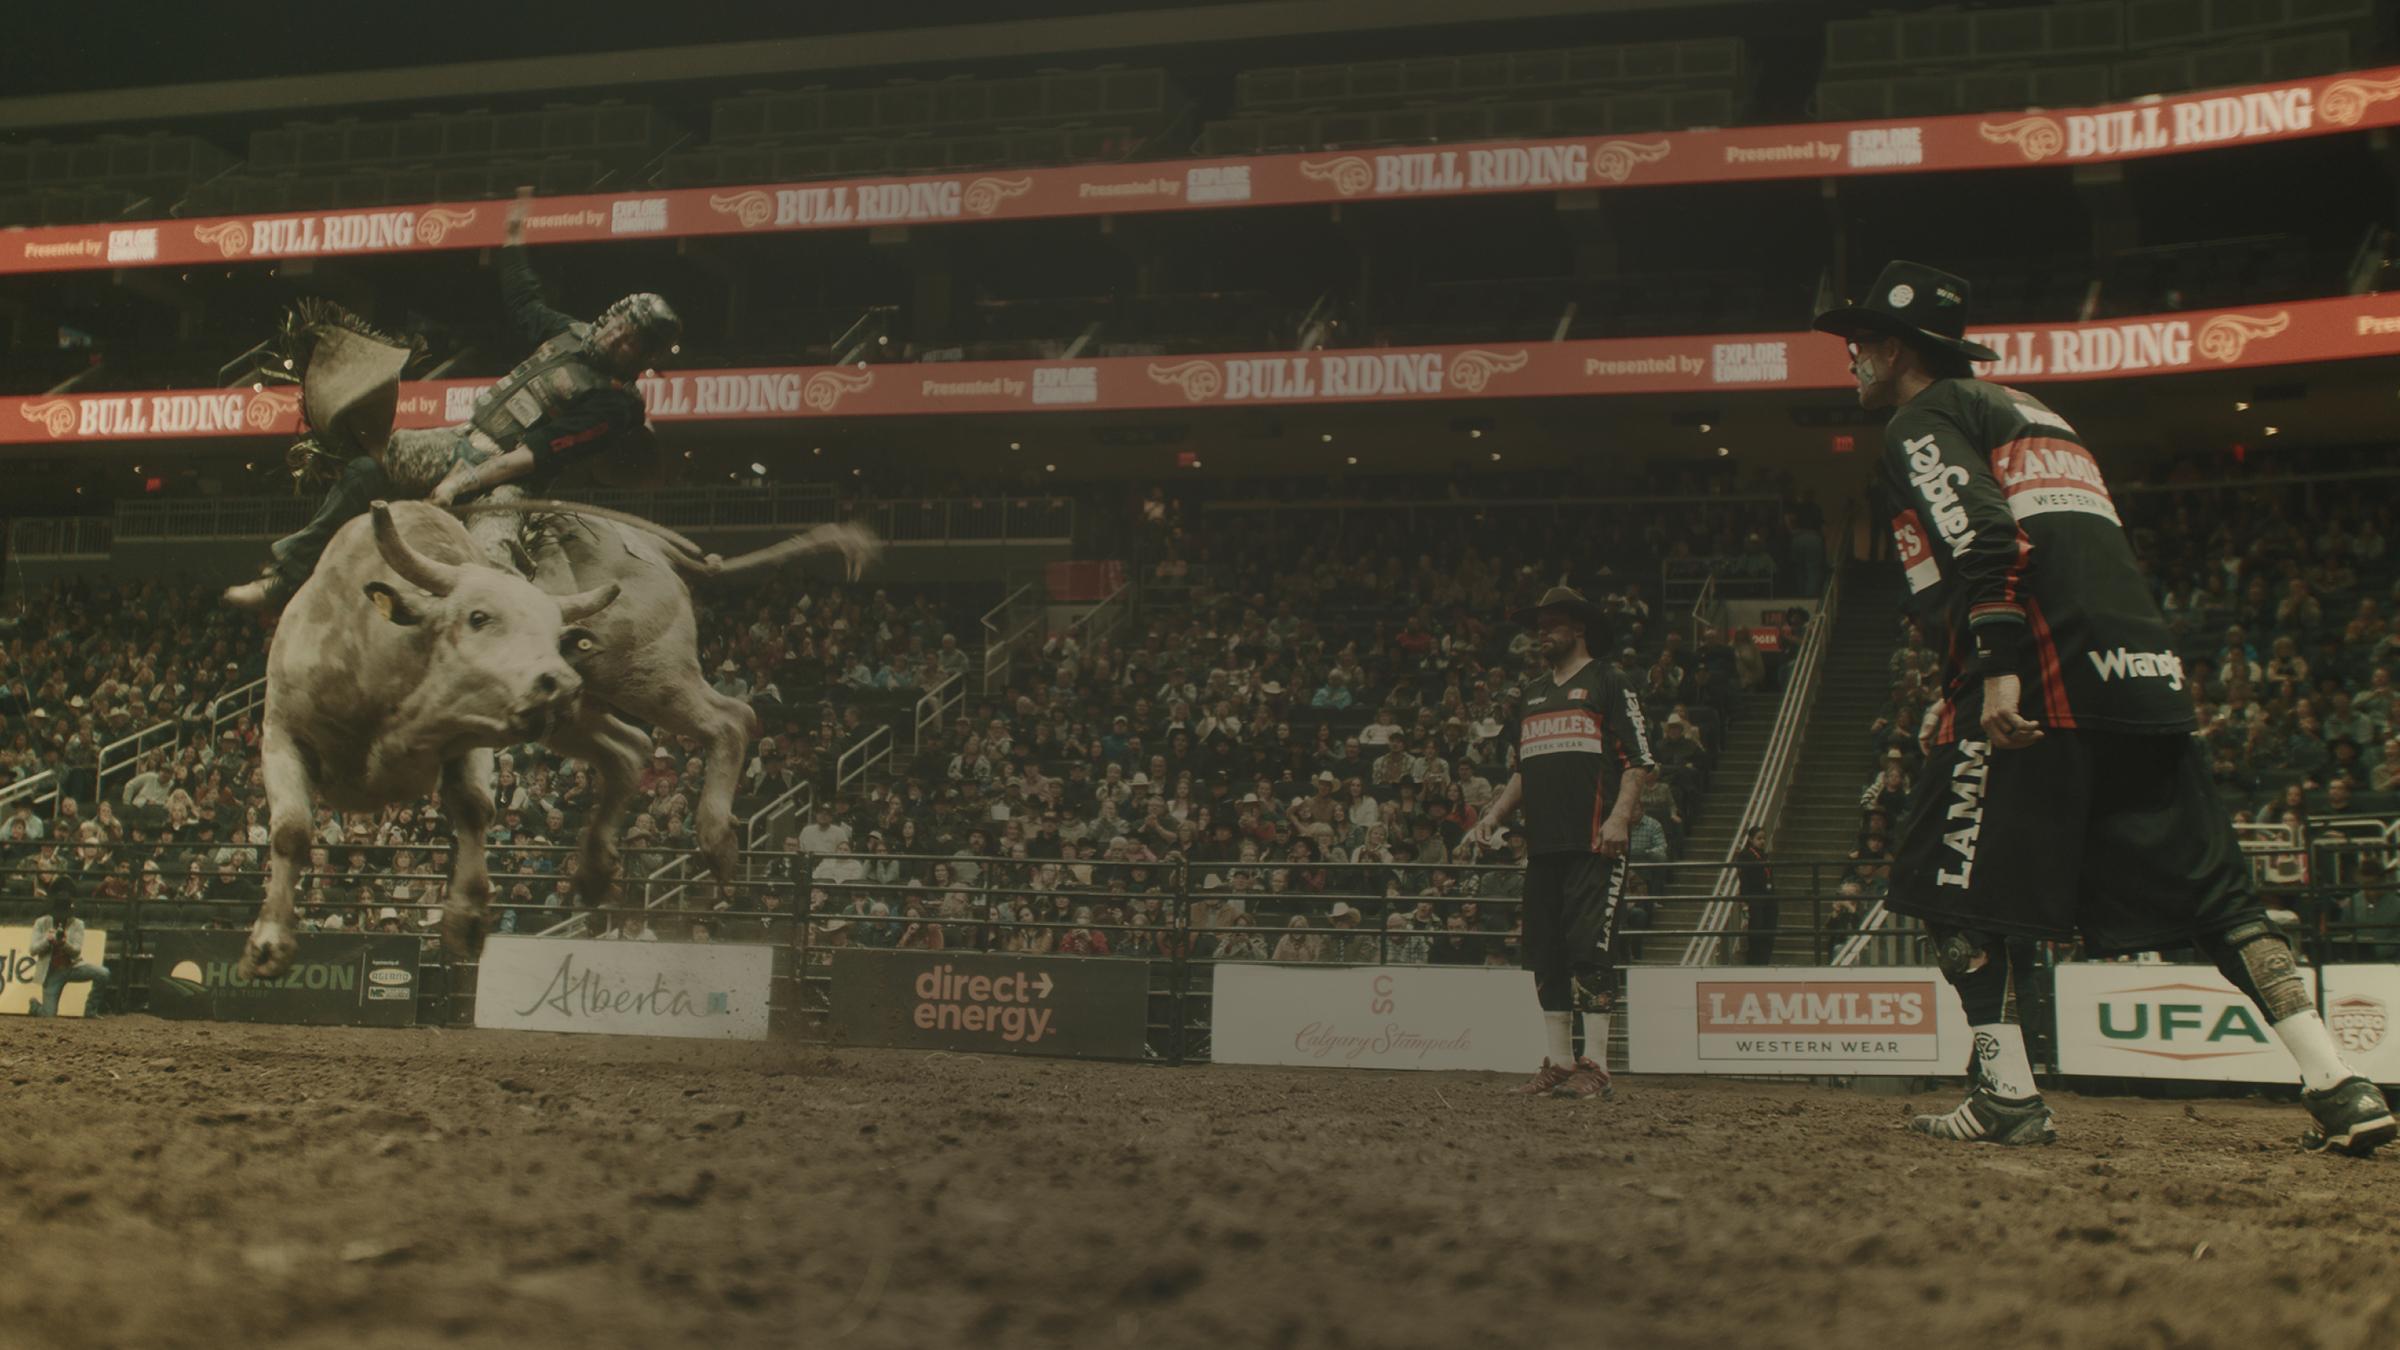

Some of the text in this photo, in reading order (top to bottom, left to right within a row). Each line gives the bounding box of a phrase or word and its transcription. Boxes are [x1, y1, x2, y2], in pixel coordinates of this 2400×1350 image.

[2065, 87, 2315, 158] BULL RIDING
[1375, 145, 1589, 194] BULL RIDING
[1726, 141, 1841, 163] Presented by
[776, 181, 962, 226] BULL RIDING
[1079, 178, 1181, 197] Presented by
[250, 211, 415, 255] BULL RIDING
[586, 209, 605, 226] by
[25, 239, 102, 258] Presented by
[1585, 355, 1704, 376] Presented by
[1713, 342, 1787, 365] EXPLORE
[2049, 320, 2192, 374] RIDING
[693, 374, 800, 415] RIDING
[922, 378, 1025, 397] Presented by
[1224, 353, 1445, 399] BULL RIDING
[78, 393, 243, 435] BULL RIDING
[419, 396, 437, 414] by
[515, 953, 707, 1017] Alberta
[915, 964, 1030, 1003] direct
[914, 1002, 1053, 1042] energy
[1709, 992, 1924, 1026] LAMMLE'S
[2098, 1003, 2270, 1043] UFA
[1295, 1021, 1472, 1059] Calgary Stampede
[1736, 1041, 1900, 1053] WESTERN WEAR
